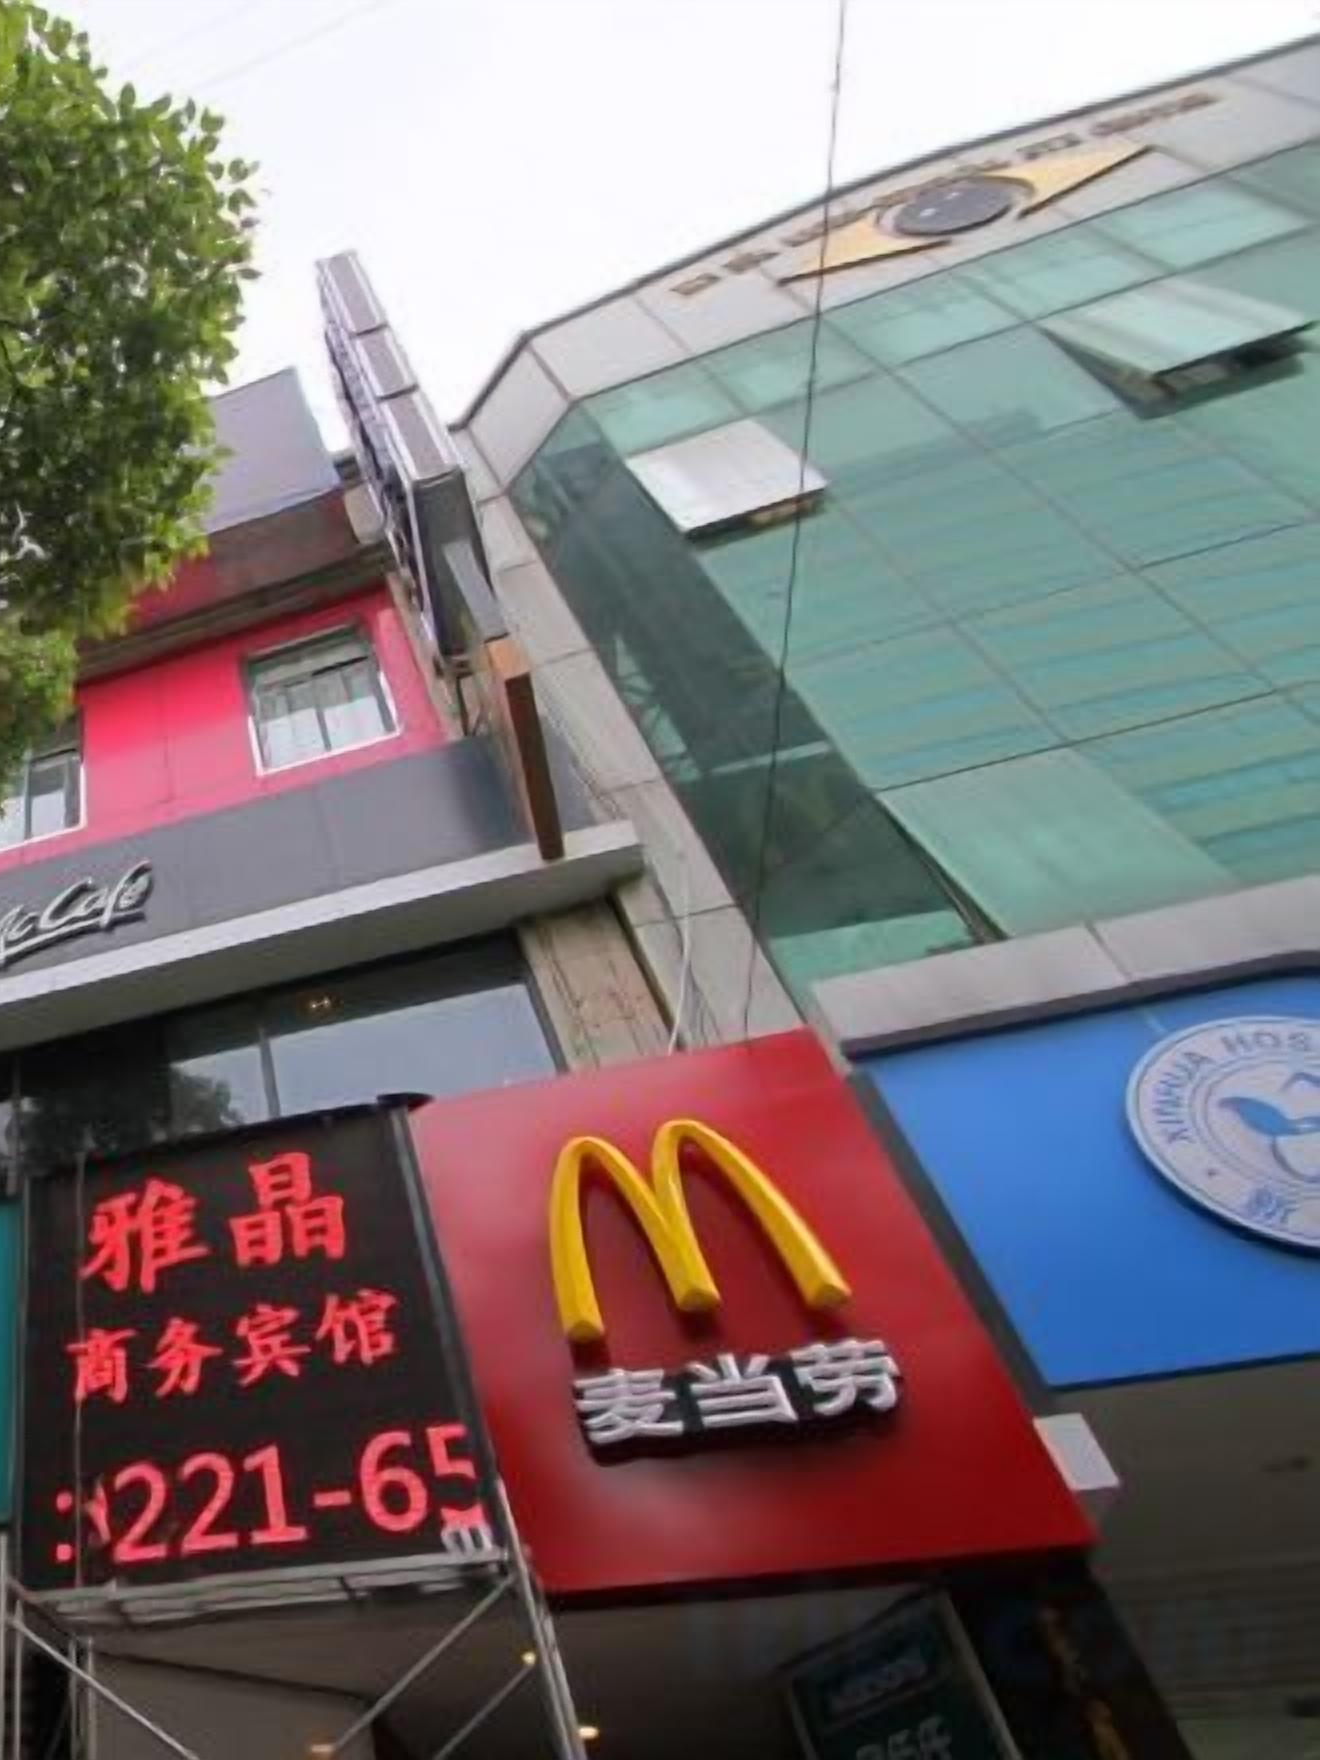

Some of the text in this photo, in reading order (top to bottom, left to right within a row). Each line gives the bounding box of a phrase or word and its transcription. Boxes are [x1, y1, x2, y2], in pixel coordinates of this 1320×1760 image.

[80, 1150, 346, 1294] 雅晶
[66, 1287, 398, 1403] 商务宾馆
[573, 1338, 901, 1446] 麦当劳
